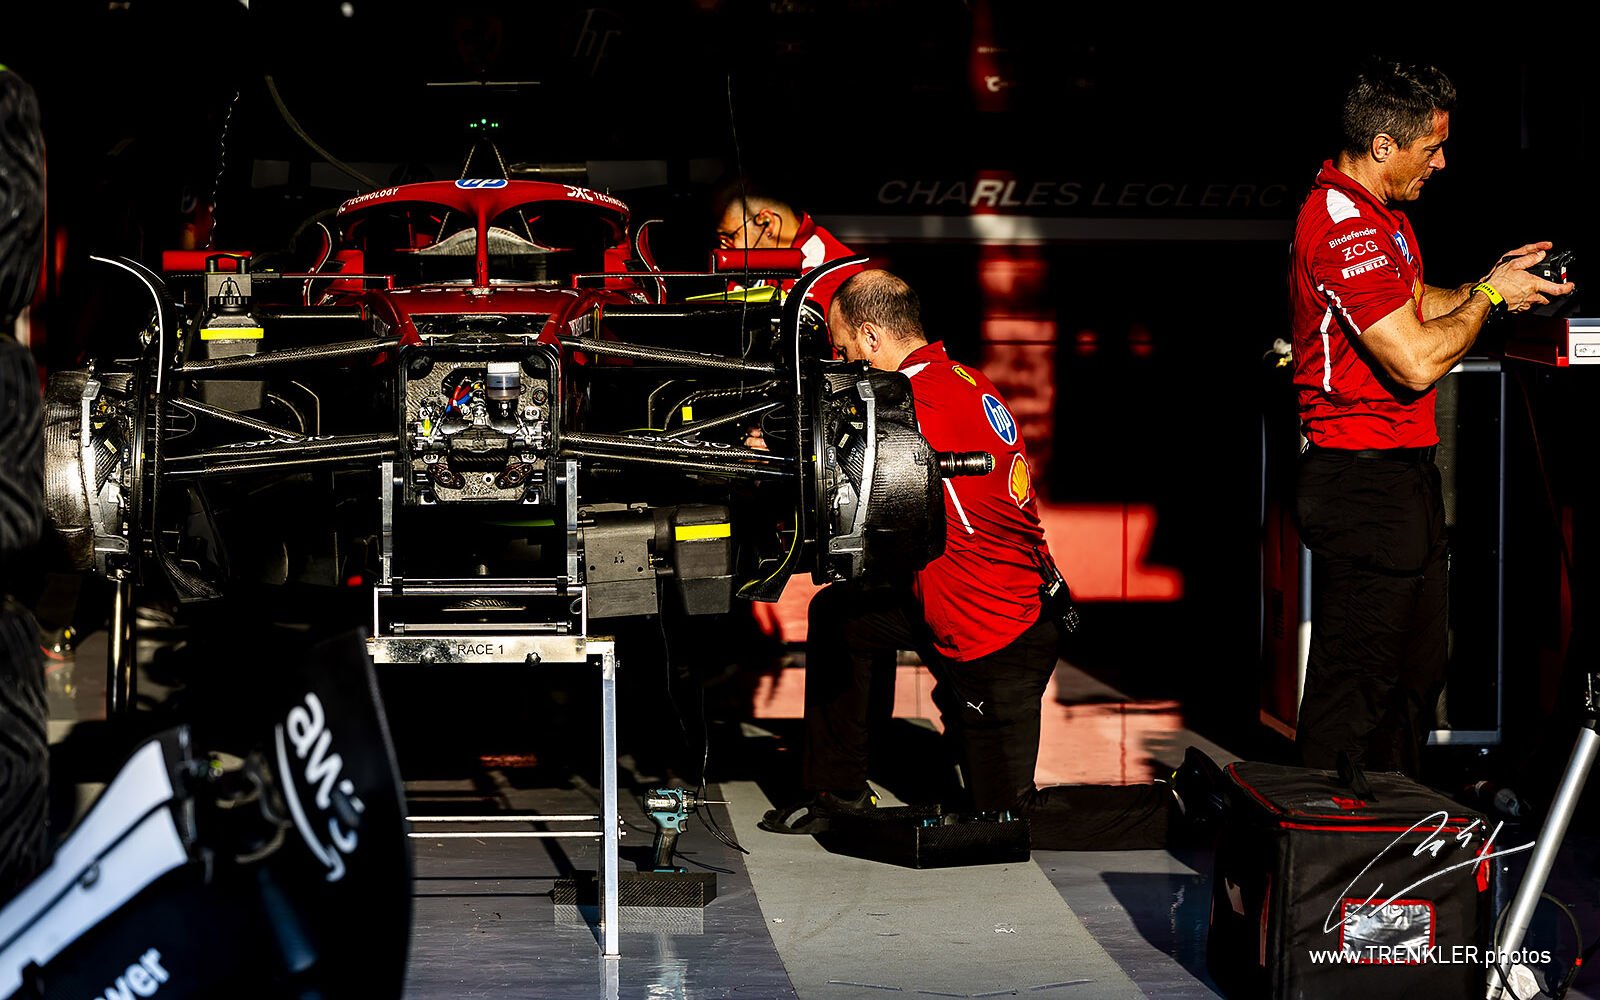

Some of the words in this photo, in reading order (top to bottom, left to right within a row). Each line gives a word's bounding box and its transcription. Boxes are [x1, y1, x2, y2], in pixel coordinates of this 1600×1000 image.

[347, 187, 399, 207] TECHNOLOGY
[563, 185, 594, 202] DXC
[876, 179, 1082, 208] CHARLES
[1089, 182, 1289, 208] LECLERC
[1328, 227, 1378, 249] Bitdefender
[1341, 240, 1379, 261] ZCG
[1341, 255, 1389, 279] PIRELLI
[982, 393, 1017, 445] hp
[457, 644, 494, 655] RACE
[498, 644, 504, 655] 1
